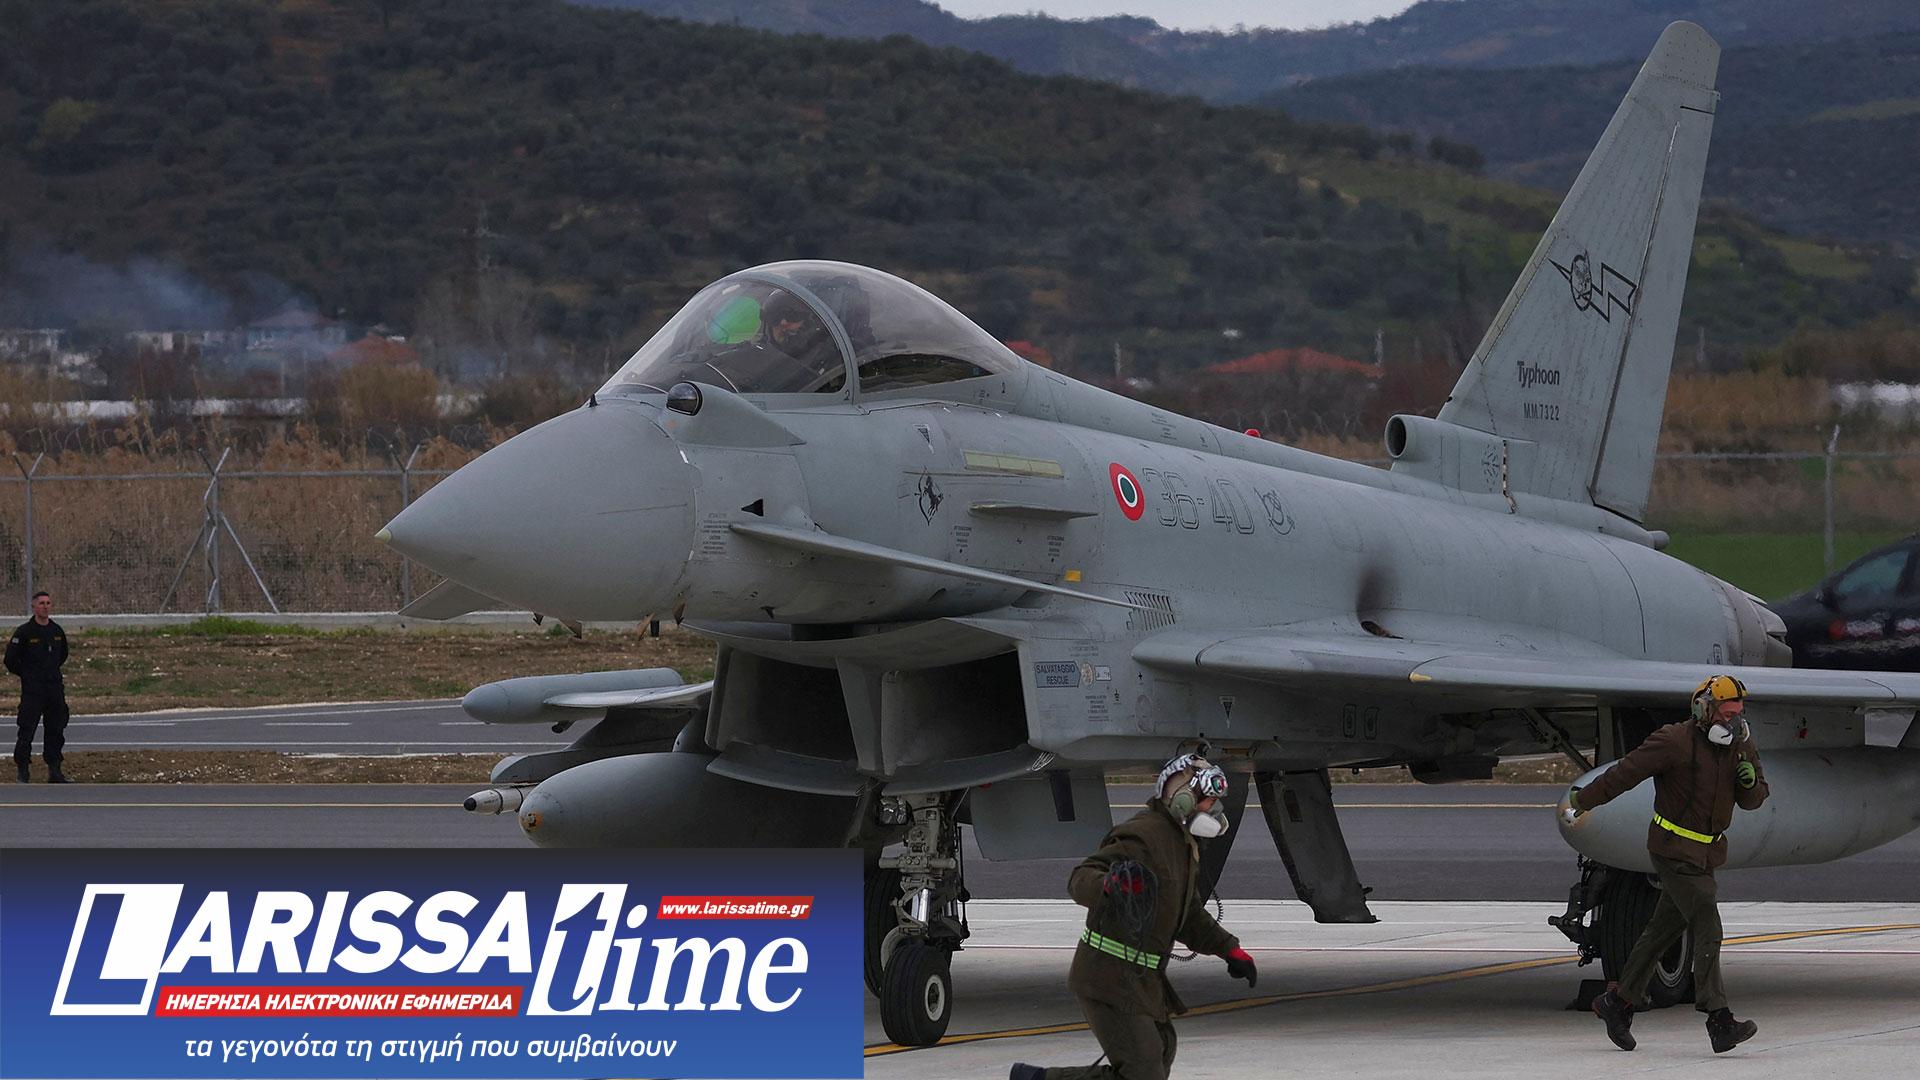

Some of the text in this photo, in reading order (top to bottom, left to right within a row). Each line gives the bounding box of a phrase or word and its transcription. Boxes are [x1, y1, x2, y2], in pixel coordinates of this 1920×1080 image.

[1517, 360, 1560, 389] Typhoon
[1035, 662, 1076, 674] SALVATAGGIO
[1046, 675, 1070, 685] RESCUE
